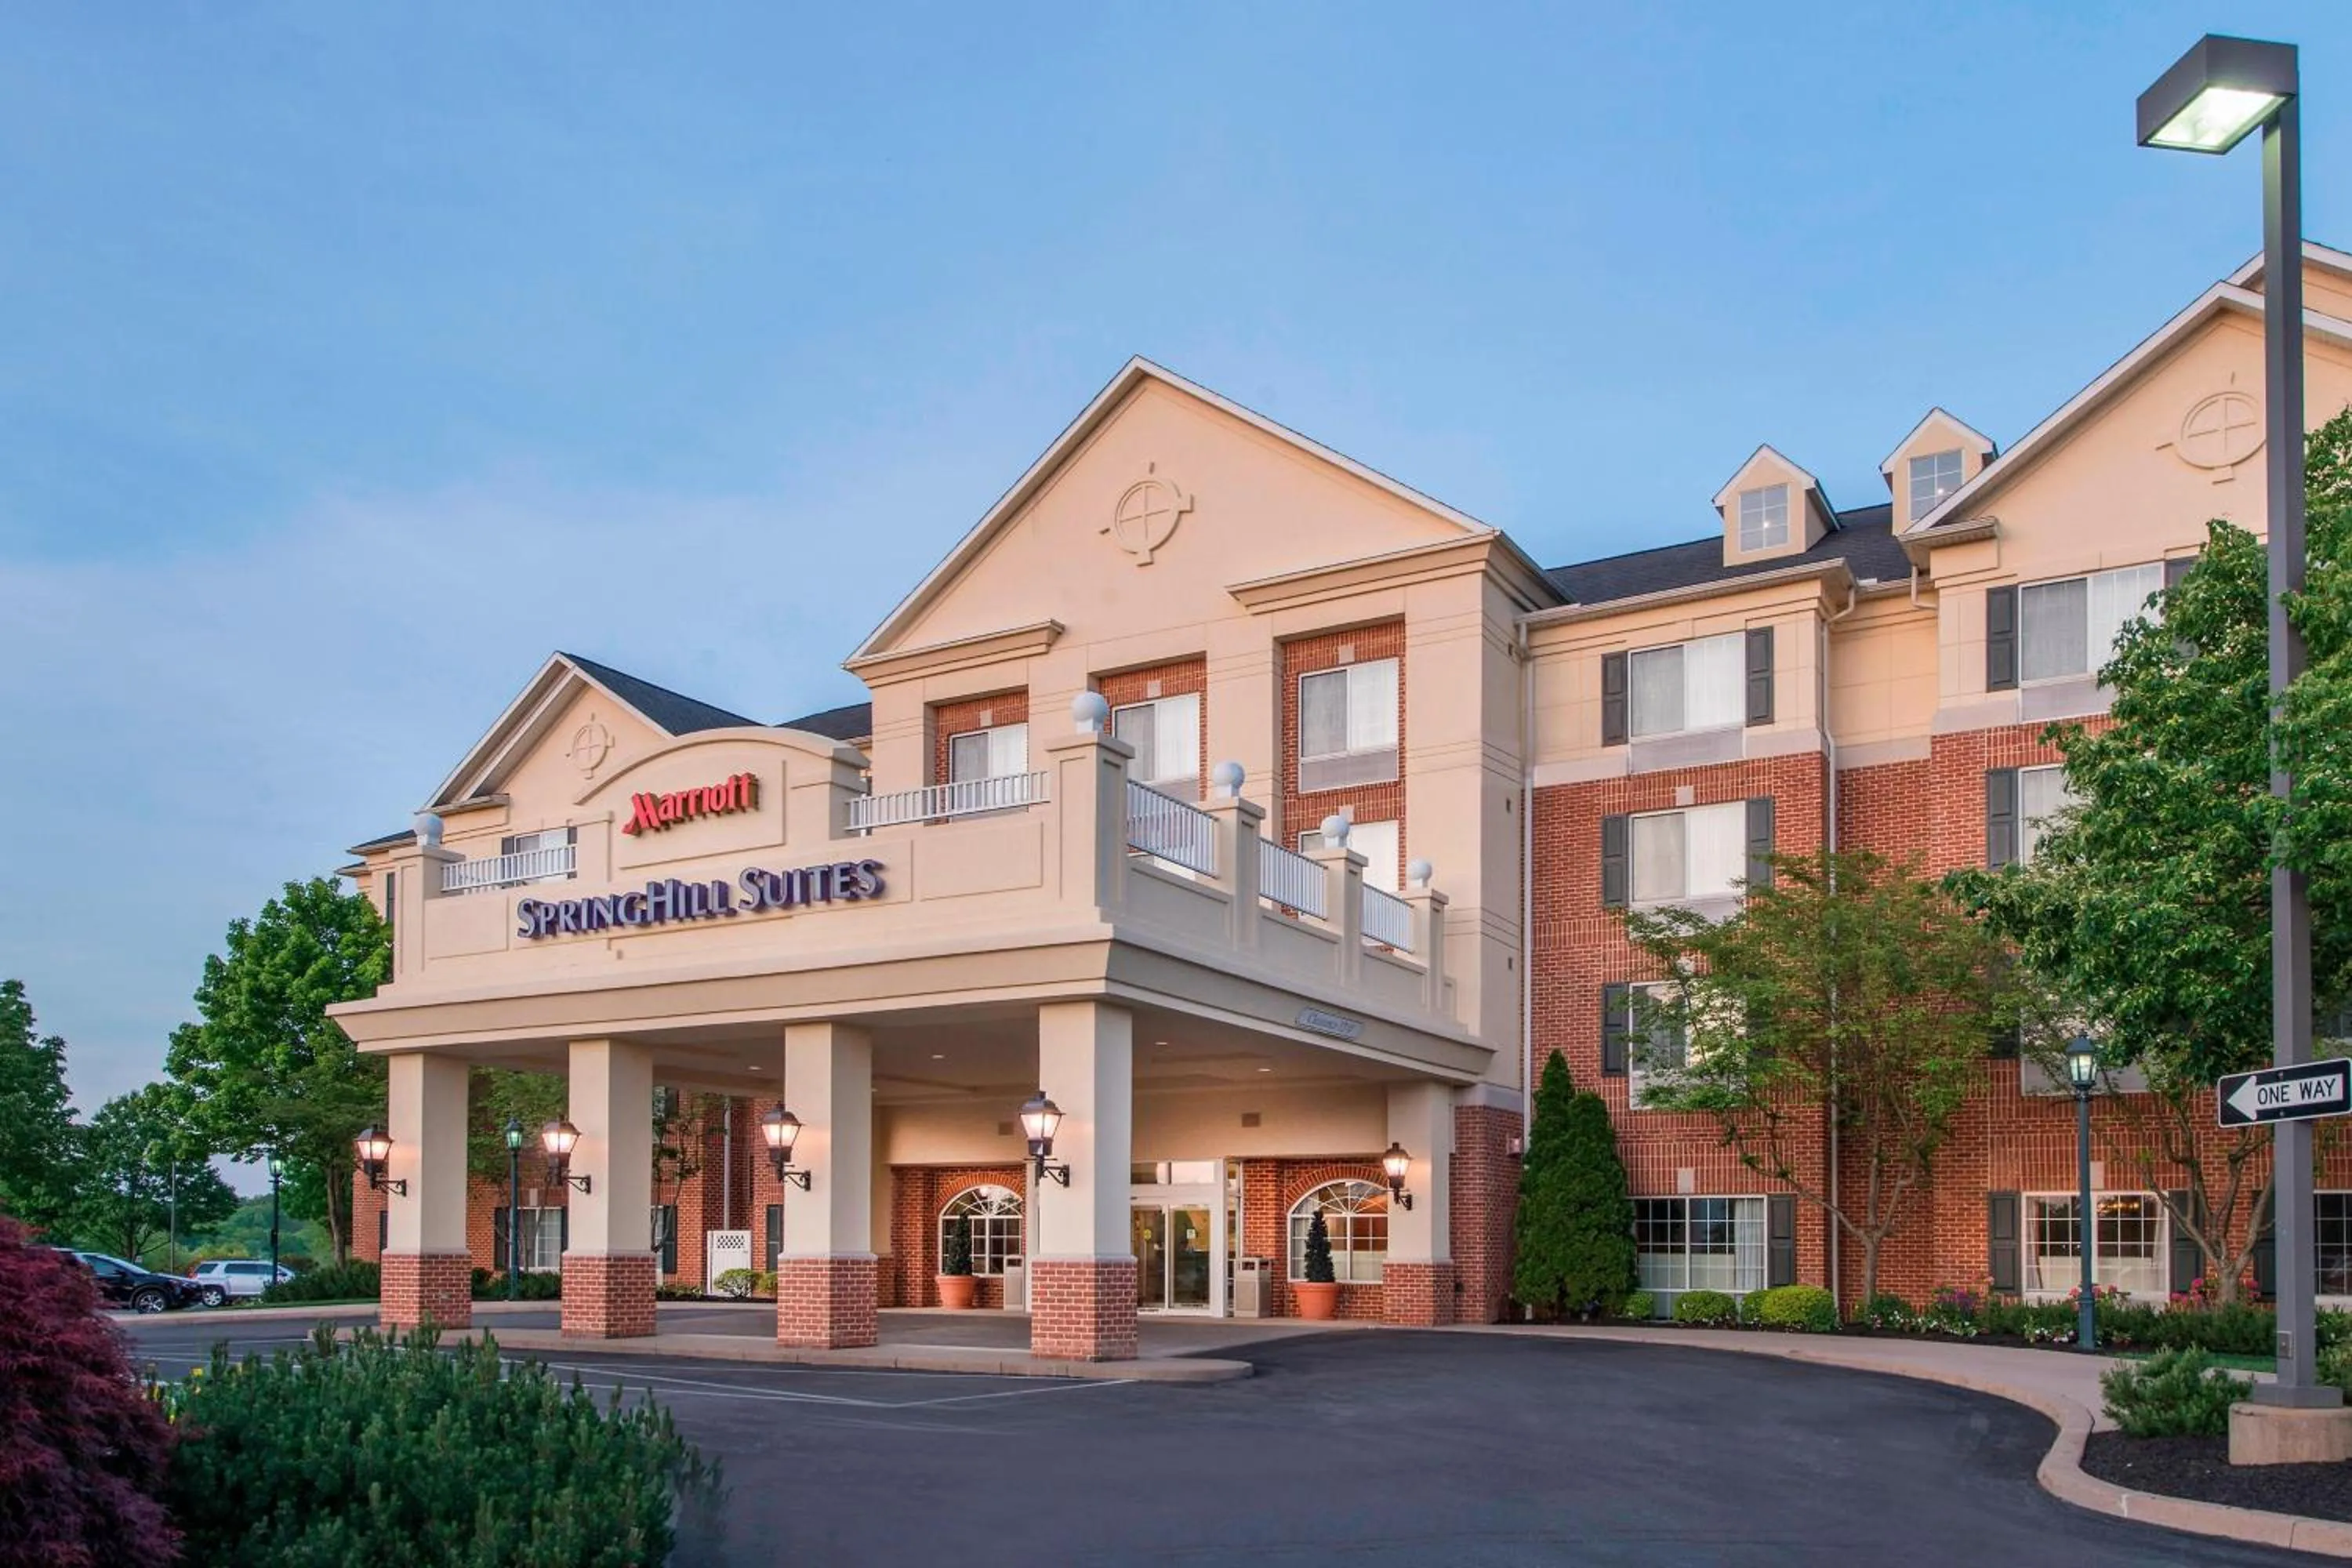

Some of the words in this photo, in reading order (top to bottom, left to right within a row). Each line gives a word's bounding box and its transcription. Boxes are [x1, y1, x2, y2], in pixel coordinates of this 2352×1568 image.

[622, 772, 759, 836] Marriott
[517, 877, 738, 938] SPRINGHILL
[739, 859, 886, 912] SUITES
[2257, 1084, 2290, 1105] ONE
[2299, 1078, 2336, 1100] WAY
